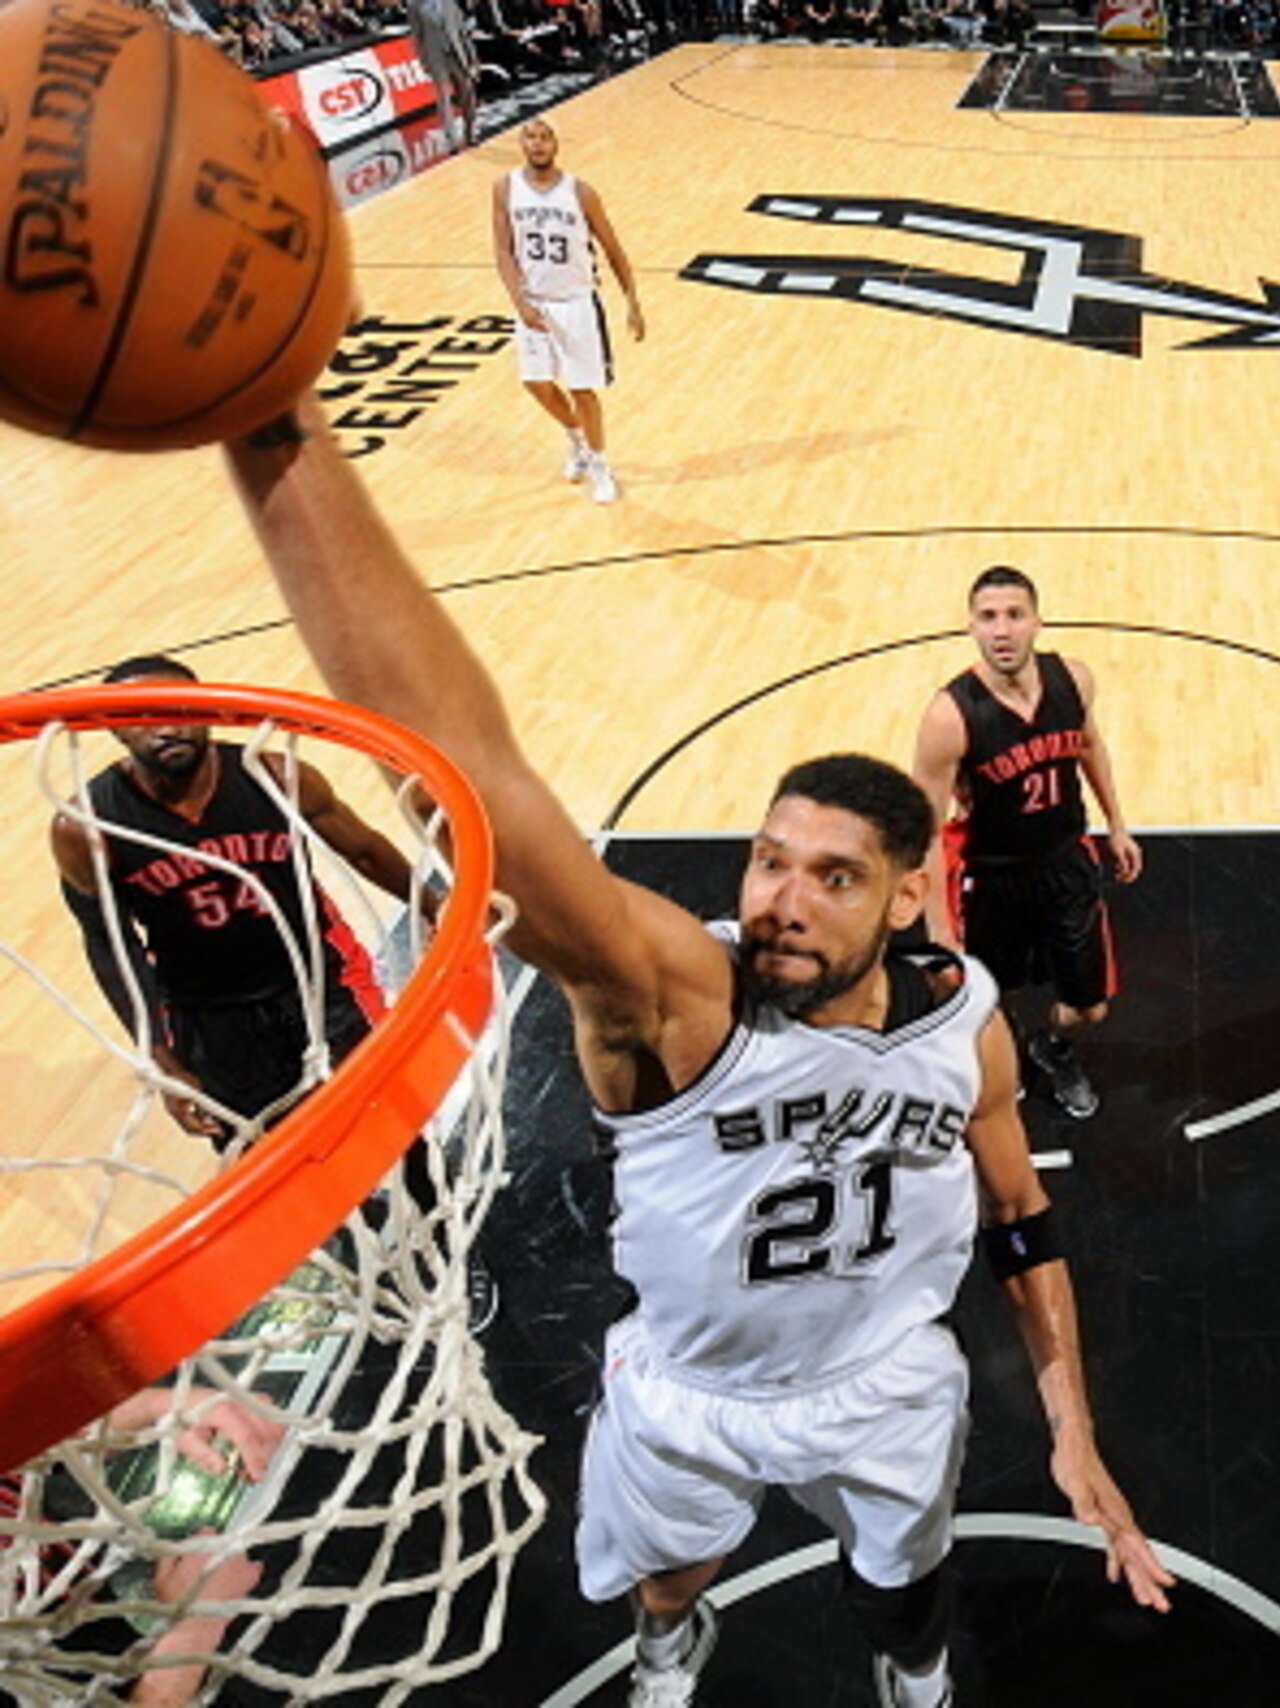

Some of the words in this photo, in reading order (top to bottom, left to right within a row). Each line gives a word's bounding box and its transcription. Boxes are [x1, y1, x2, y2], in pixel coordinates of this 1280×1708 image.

[319, 78, 366, 116] CST
[5, 2, 142, 307] SPALDING
[527, 232, 568, 265] 33
[1020, 766, 1061, 814] 21
[187, 871, 272, 929] 54
[713, 1088, 966, 1177] SPURS
[740, 1162, 897, 1286] 21
